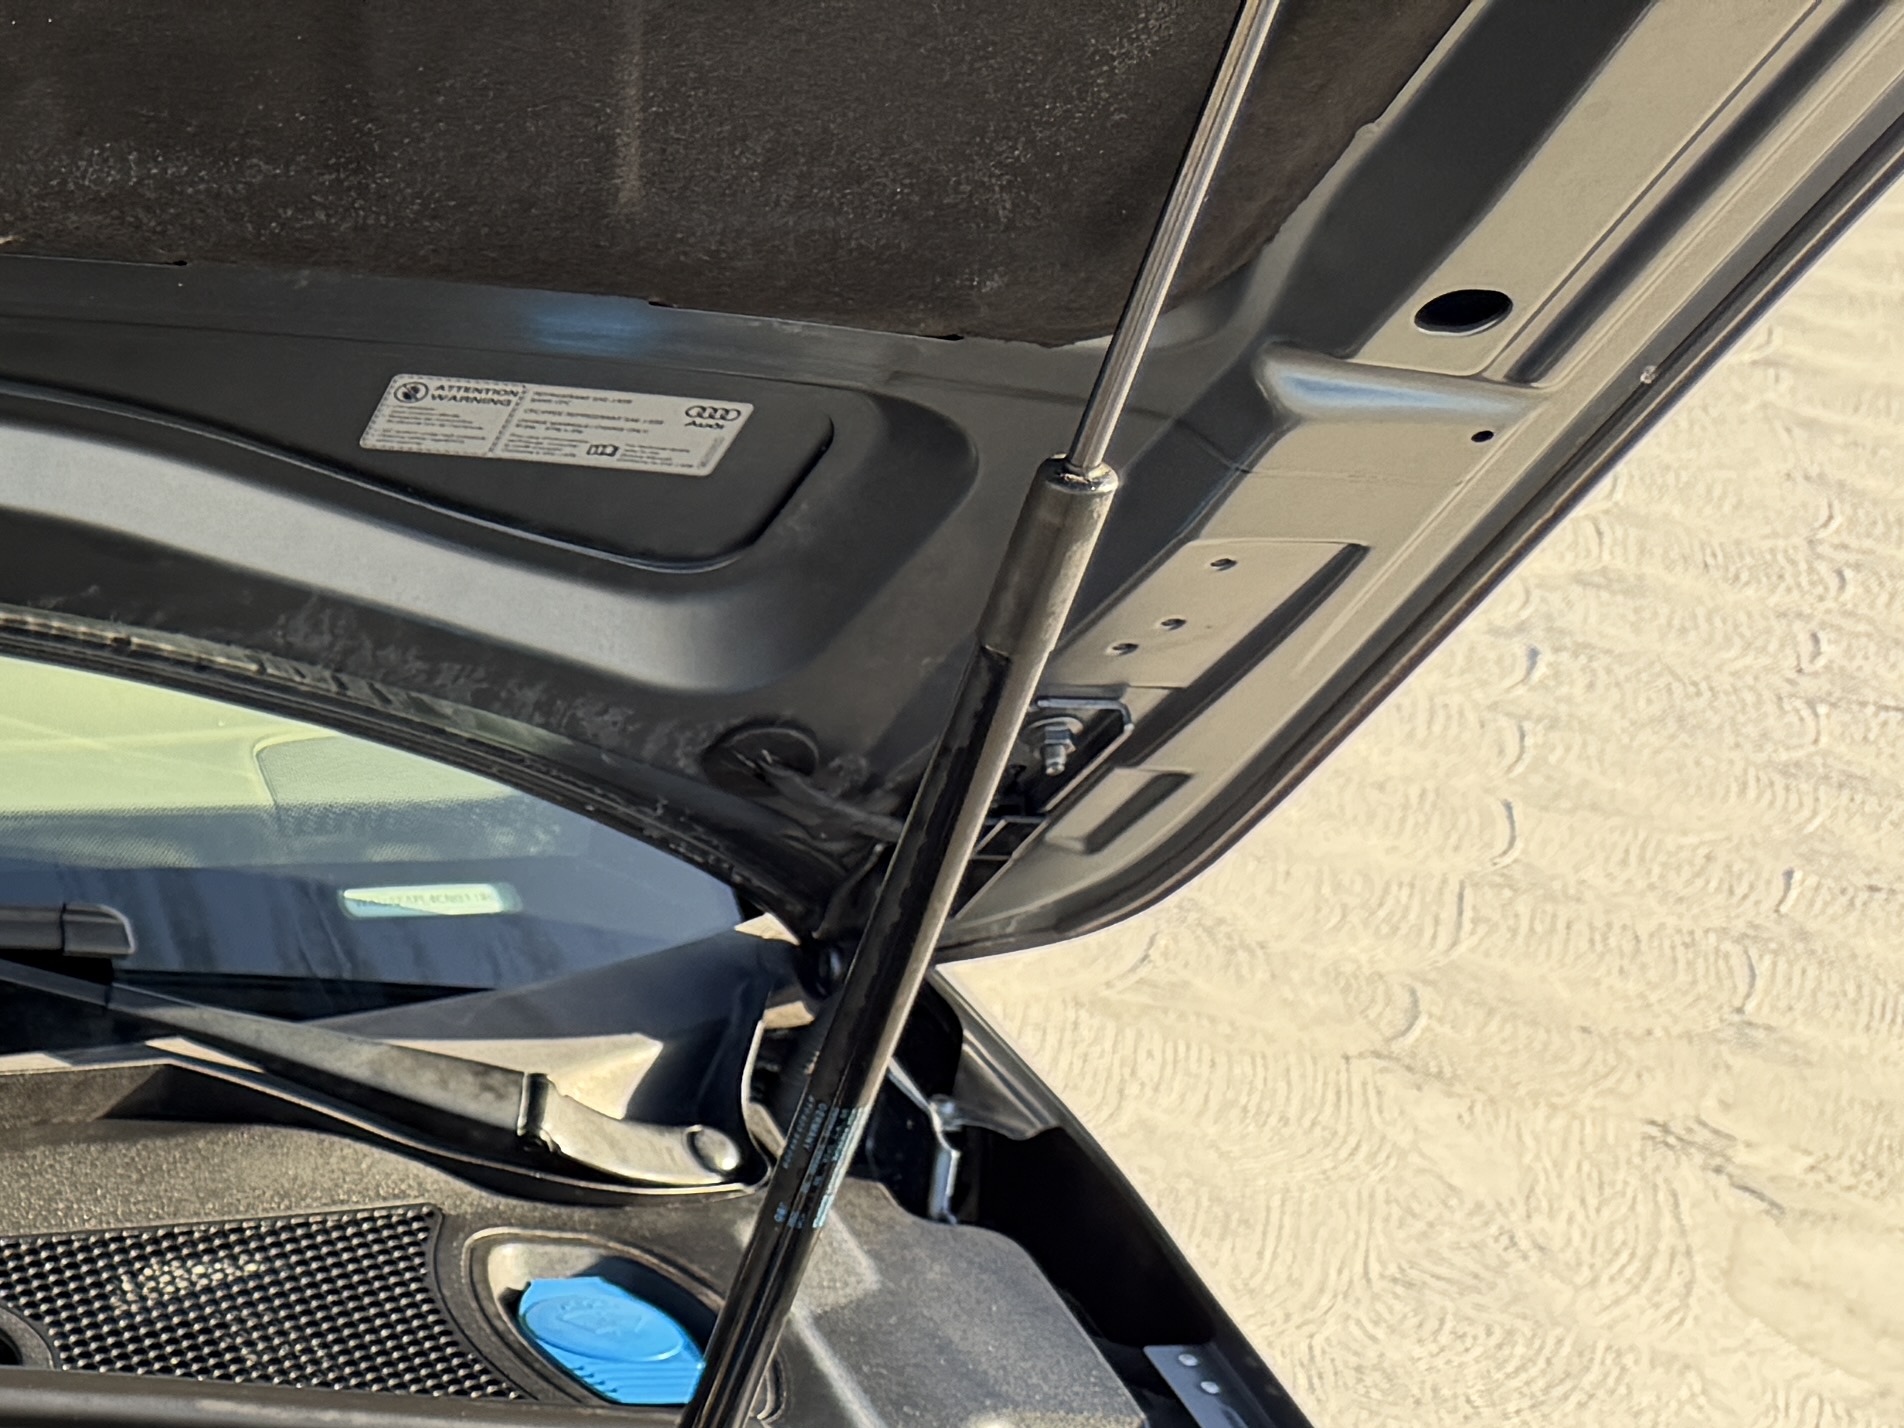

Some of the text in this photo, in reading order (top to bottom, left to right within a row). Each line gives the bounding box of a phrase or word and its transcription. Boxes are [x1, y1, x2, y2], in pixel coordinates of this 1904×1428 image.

[434, 384, 519, 397] ATTENTION
[431, 393, 512, 407] WARNING
[684, 420, 725, 430] Audi
